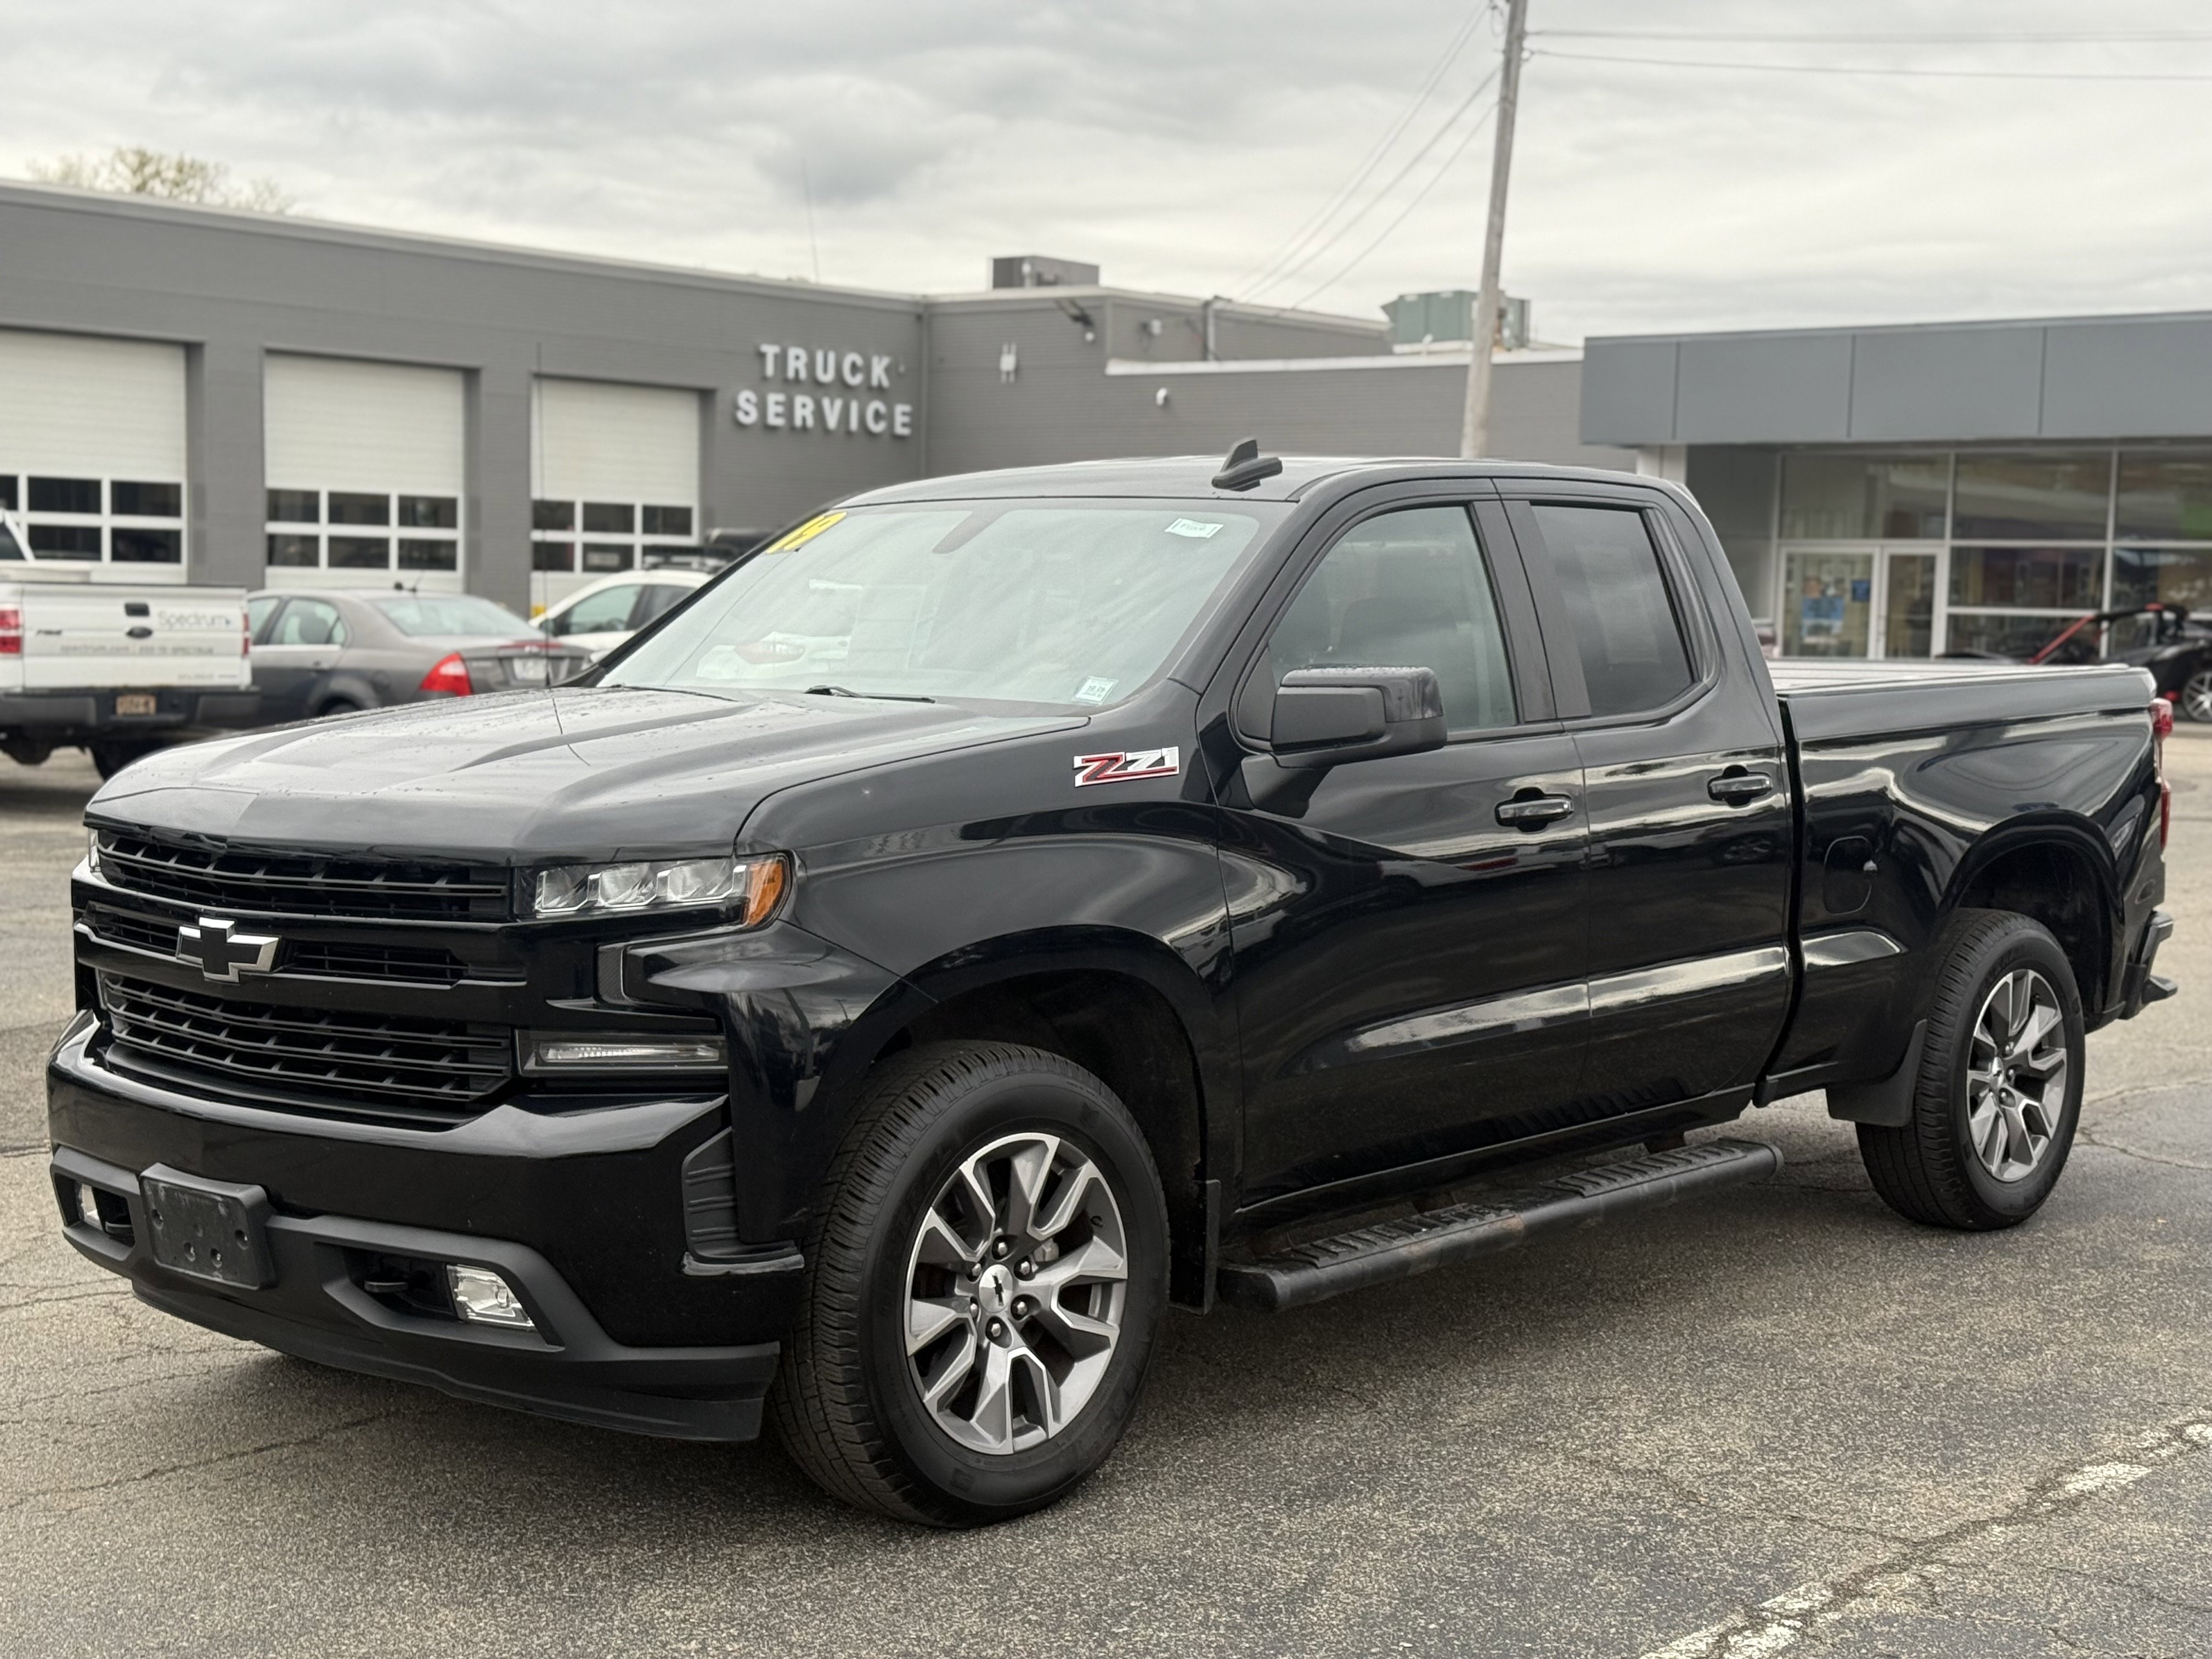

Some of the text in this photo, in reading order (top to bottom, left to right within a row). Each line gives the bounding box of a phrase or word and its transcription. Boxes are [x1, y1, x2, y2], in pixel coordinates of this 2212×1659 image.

[760, 343, 891, 388] TRUCK
[736, 390, 912, 435] SERVICE
[158, 611, 228, 629] Spectrum
[1074, 746, 1180, 787] Z71
